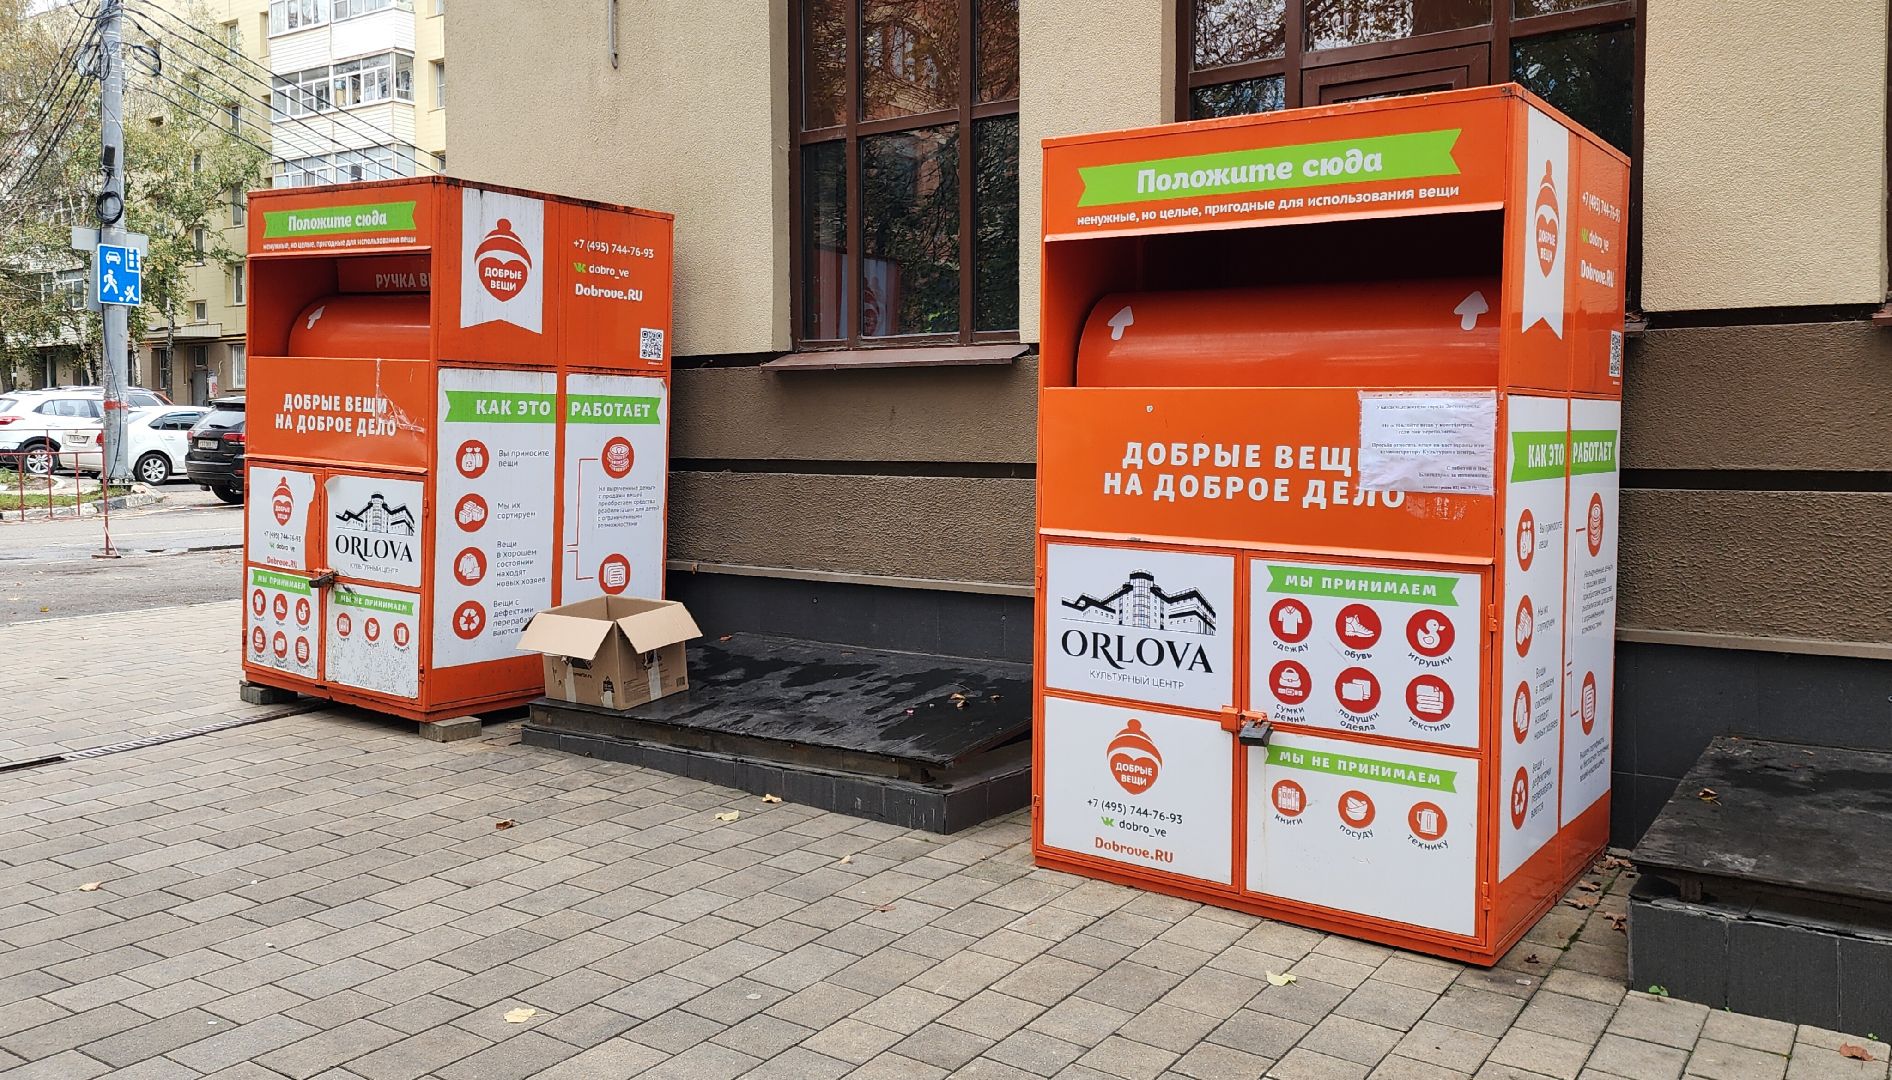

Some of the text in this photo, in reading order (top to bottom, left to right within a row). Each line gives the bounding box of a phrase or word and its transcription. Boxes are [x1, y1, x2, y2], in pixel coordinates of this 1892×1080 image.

[1137, 148, 1382, 195] Положите сюда
[1077, 185, 1460, 227] ненужные, но целые, пригодные для использования вещи
[288, 209, 388, 232] Положите сюда
[573, 240, 654, 258] +7 (495) 744-76-93
[375, 272, 432, 289] РУЧКА В
[484, 266, 523, 280] ДОБРЫЕ
[589, 264, 630, 280] dobro_ve
[490, 280, 517, 292] ВЕЩИ
[575, 283, 643, 302] Dobrove.RU
[283, 393, 388, 416] ДОБРЫЕ ВЕЩИ
[475, 400, 651, 418] КАК ЭТО РАБОТАЕТ
[275, 413, 398, 437] НА ДОБРОЕ ДЕЛО
[498, 449, 550, 459] Вы приносите
[1122, 442, 1362, 477] ДОБРЫЕ ВЕЩ
[1528, 440, 1613, 469] КАК ЭТО РАБОТАЕТ
[498, 460, 518, 469] вещи
[1104, 472, 1406, 510] НА ДОБРОЕ ДЕЛО
[497, 502, 509, 510] Мы
[497, 511, 536, 521] сортируем
[335, 534, 413, 563] ORLOVA
[497, 540, 517, 549] Вещи
[502, 549, 537, 559] хорошем
[496, 559, 534, 568] состоянии
[496, 569, 526, 578] находят
[269, 577, 307, 591] ПРИНИМАЕМ
[496, 577, 546, 588] новых хозяев
[1285, 575, 1437, 597] МЫ ПРИНИМАЕМ
[364, 597, 408, 612] ПРИНИМАЕМ
[493, 600, 514, 608] Вещи
[493, 607, 534, 618] дефектами
[1061, 629, 1214, 674] ORLOVA
[1272, 638, 1309, 653] одежду
[1344, 650, 1373, 662] обувь
[1408, 651, 1453, 668] игрушки
[1089, 669, 1185, 691] КУЛЬТУРНЫЙ ЦЕНТР
[1275, 703, 1305, 714] сумки
[1337, 707, 1380, 724] подушки
[1273, 712, 1306, 723] ремни
[1408, 716, 1452, 733] текстиль
[1340, 720, 1376, 733] одеяла
[1115, 762, 1153, 777] ДОБРЫЕ
[1279, 751, 1441, 786] МЫ НЕ ПРИНИМАЕМ
[1120, 774, 1147, 787] ВЕЩИ
[1087, 799, 1183, 825] +7 (495) 744-76-93
[1274, 813, 1303, 827] книги
[1119, 819, 1167, 839] dobro_ve
[1338, 823, 1374, 840] посуду
[1094, 836, 1174, 864] Dobrove.RU
[1407, 834, 1449, 851] технику
